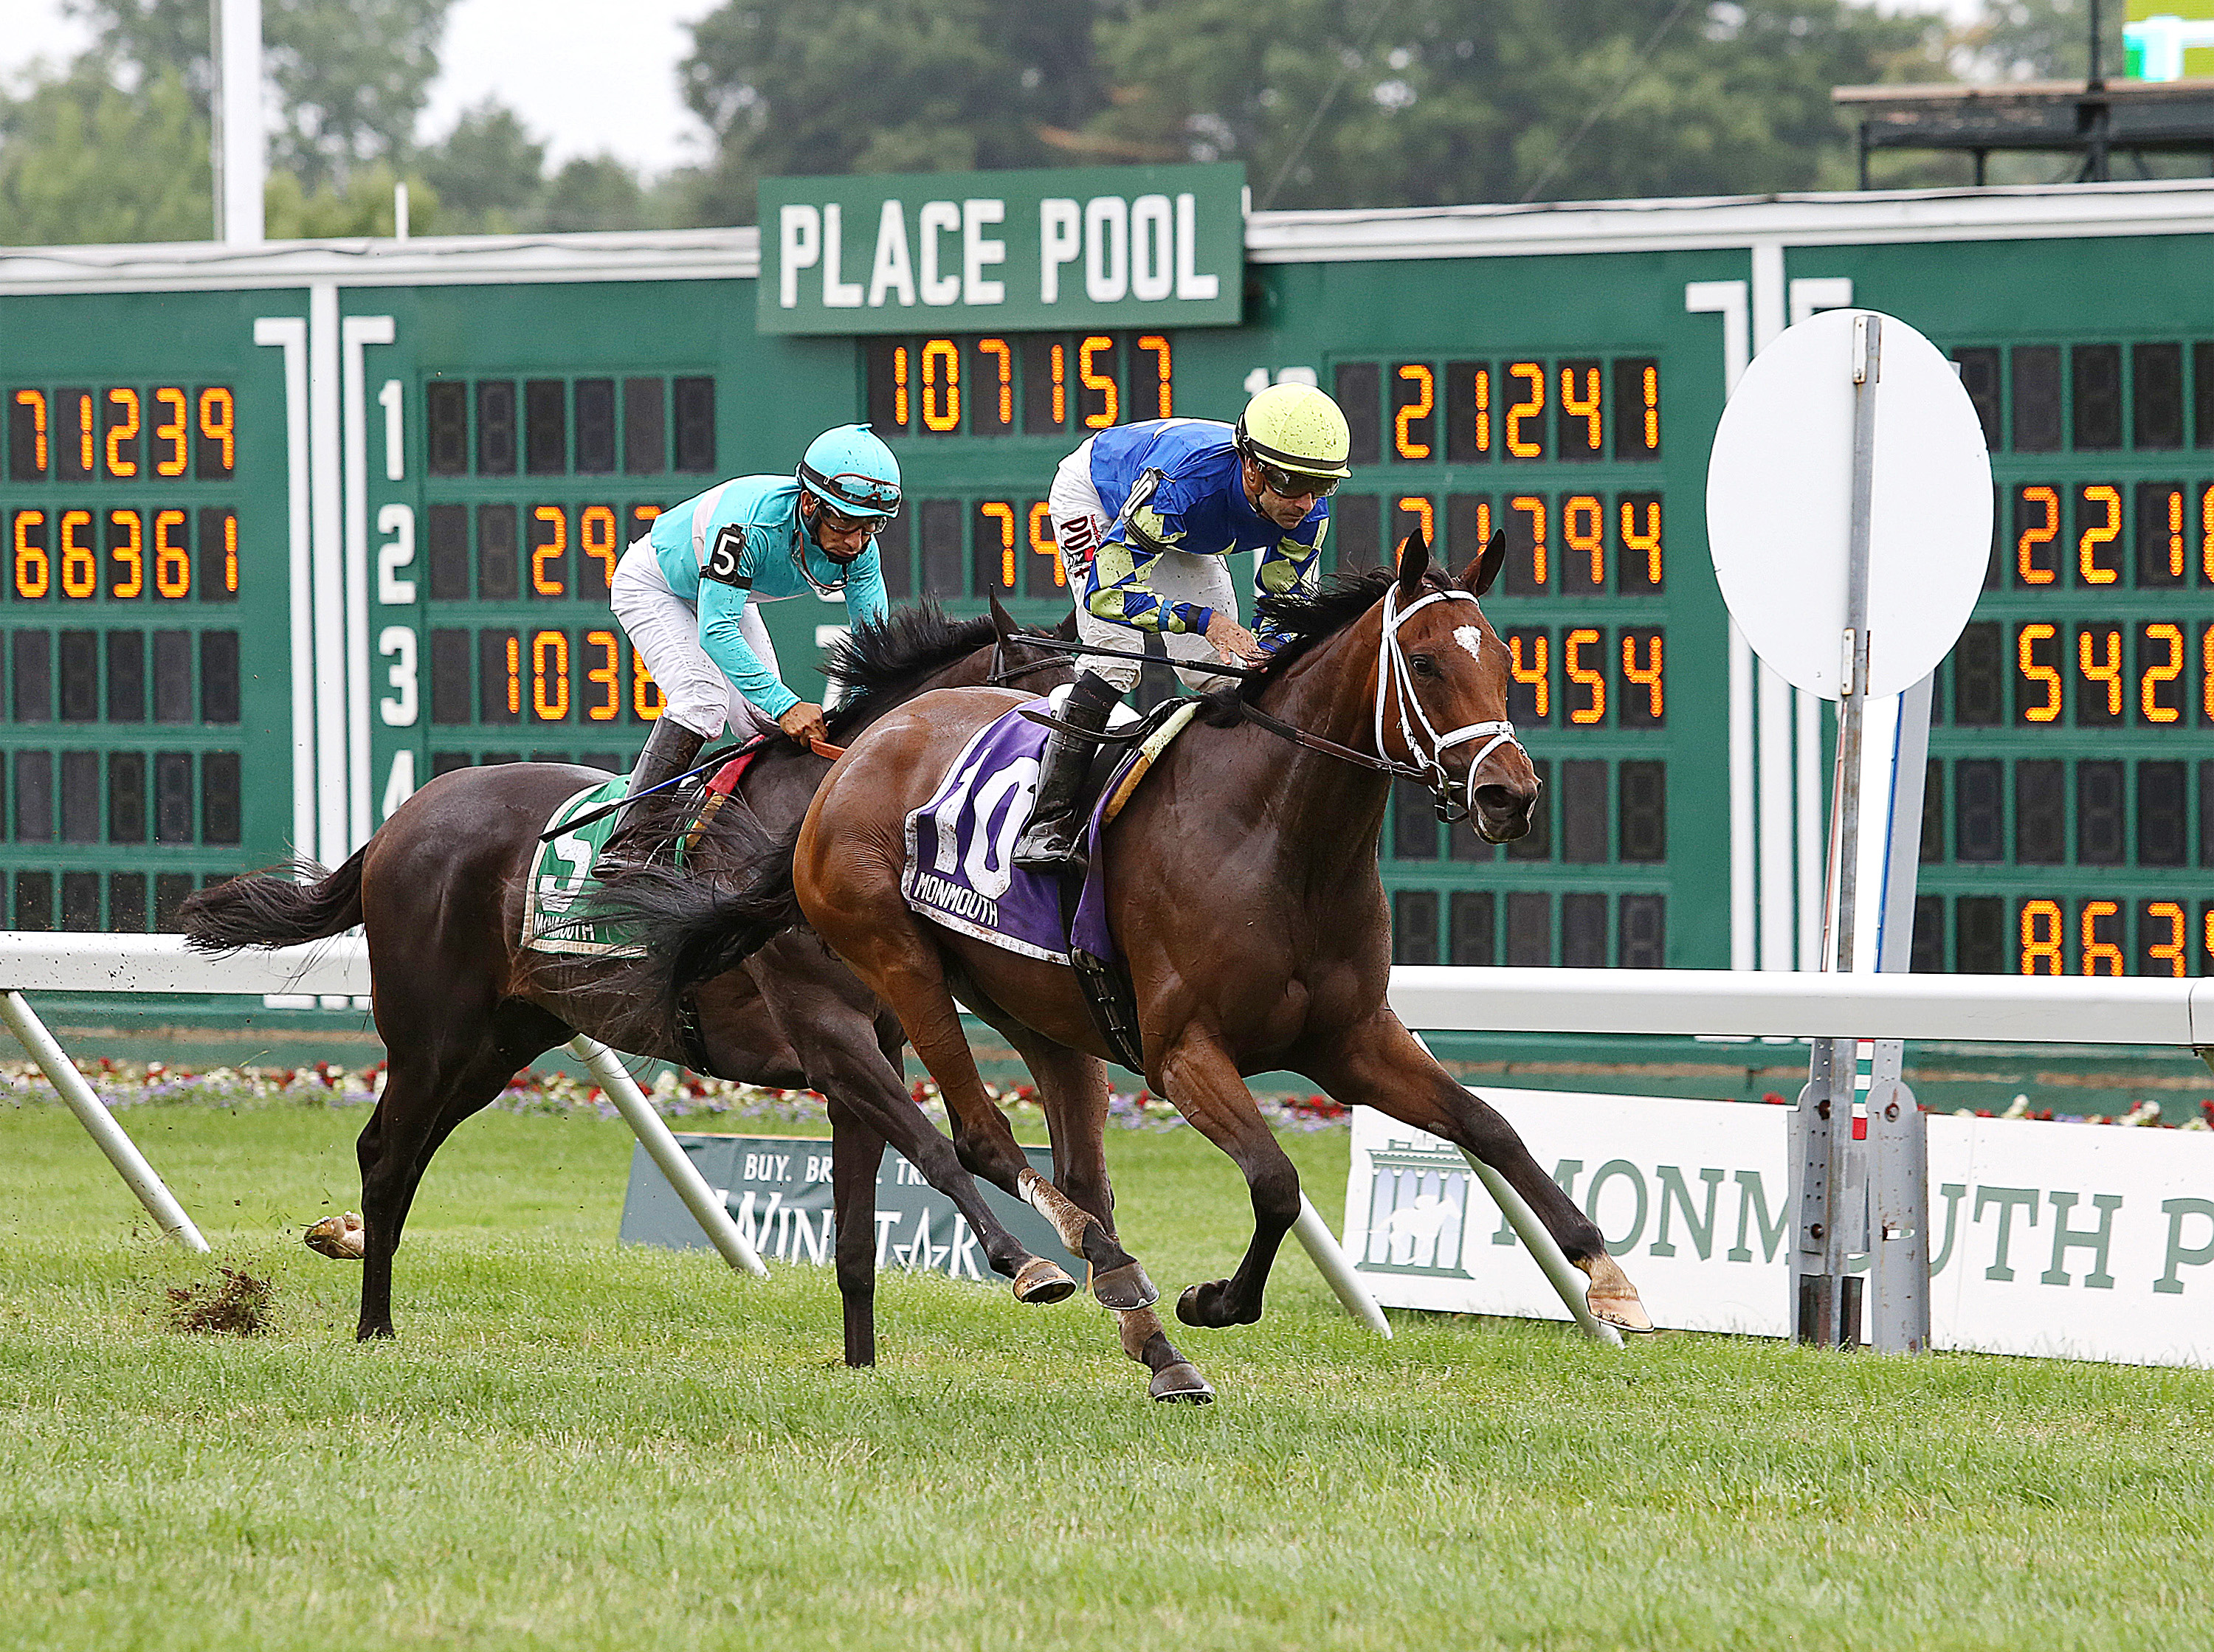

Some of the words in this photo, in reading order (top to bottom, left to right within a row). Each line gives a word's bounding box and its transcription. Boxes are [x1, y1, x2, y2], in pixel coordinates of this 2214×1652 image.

[779, 198, 1006, 309] PLACE
[1039, 192, 1220, 304] POOL
[15, 387, 235, 477] 71239
[378, 379, 404, 481] 1
[893, 335, 1173, 432] 107157
[1394, 362, 1660, 460] 21241
[1122, 470, 1153, 517] 10
[13, 509, 239, 599] 66361
[377, 503, 416, 605] 2
[712, 534, 740, 576] 5
[378, 625, 418, 727] 3
[933, 747, 1041, 901] 10
[913, 871, 999, 928] MONMOUTH
[743, 1153, 792, 1183] BUY.
